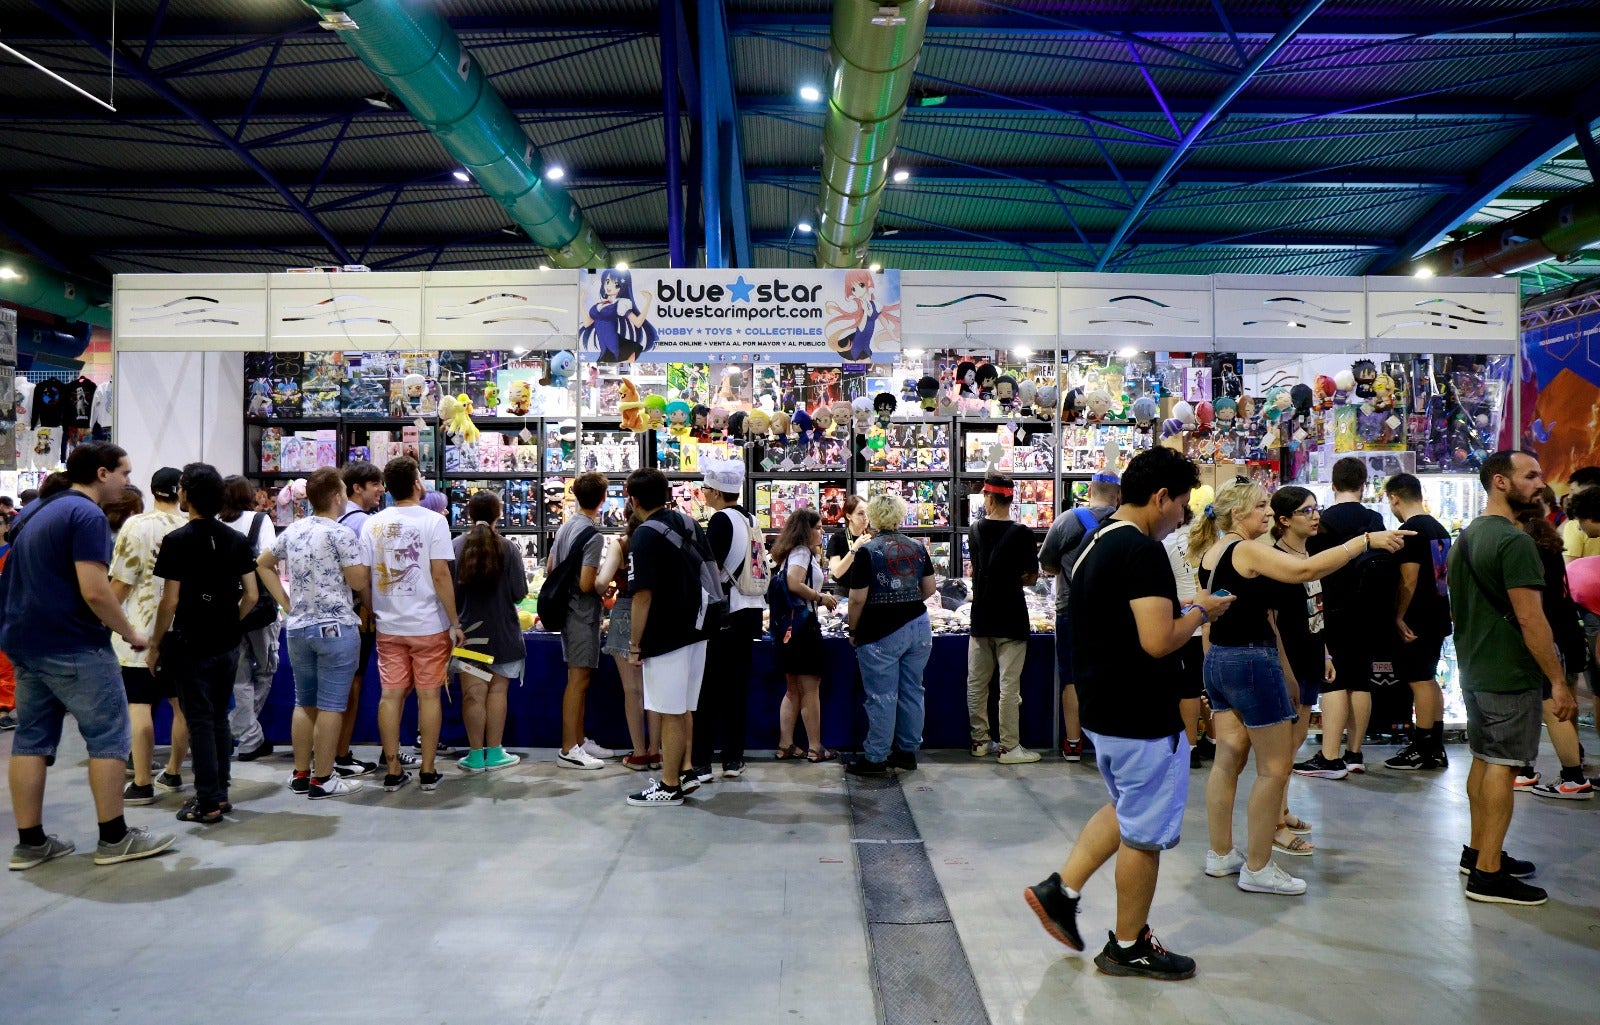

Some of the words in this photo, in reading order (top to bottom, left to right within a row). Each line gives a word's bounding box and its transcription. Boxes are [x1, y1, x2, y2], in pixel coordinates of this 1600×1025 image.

[657, 279, 725, 303] blue
[756, 279, 823, 303] star
[656, 304, 823, 321] bluestarimport.com
[658, 327, 693, 336] HOBBY
[704, 327, 733, 336] TOYS
[744, 327, 823, 336] COLLECTIBLES
